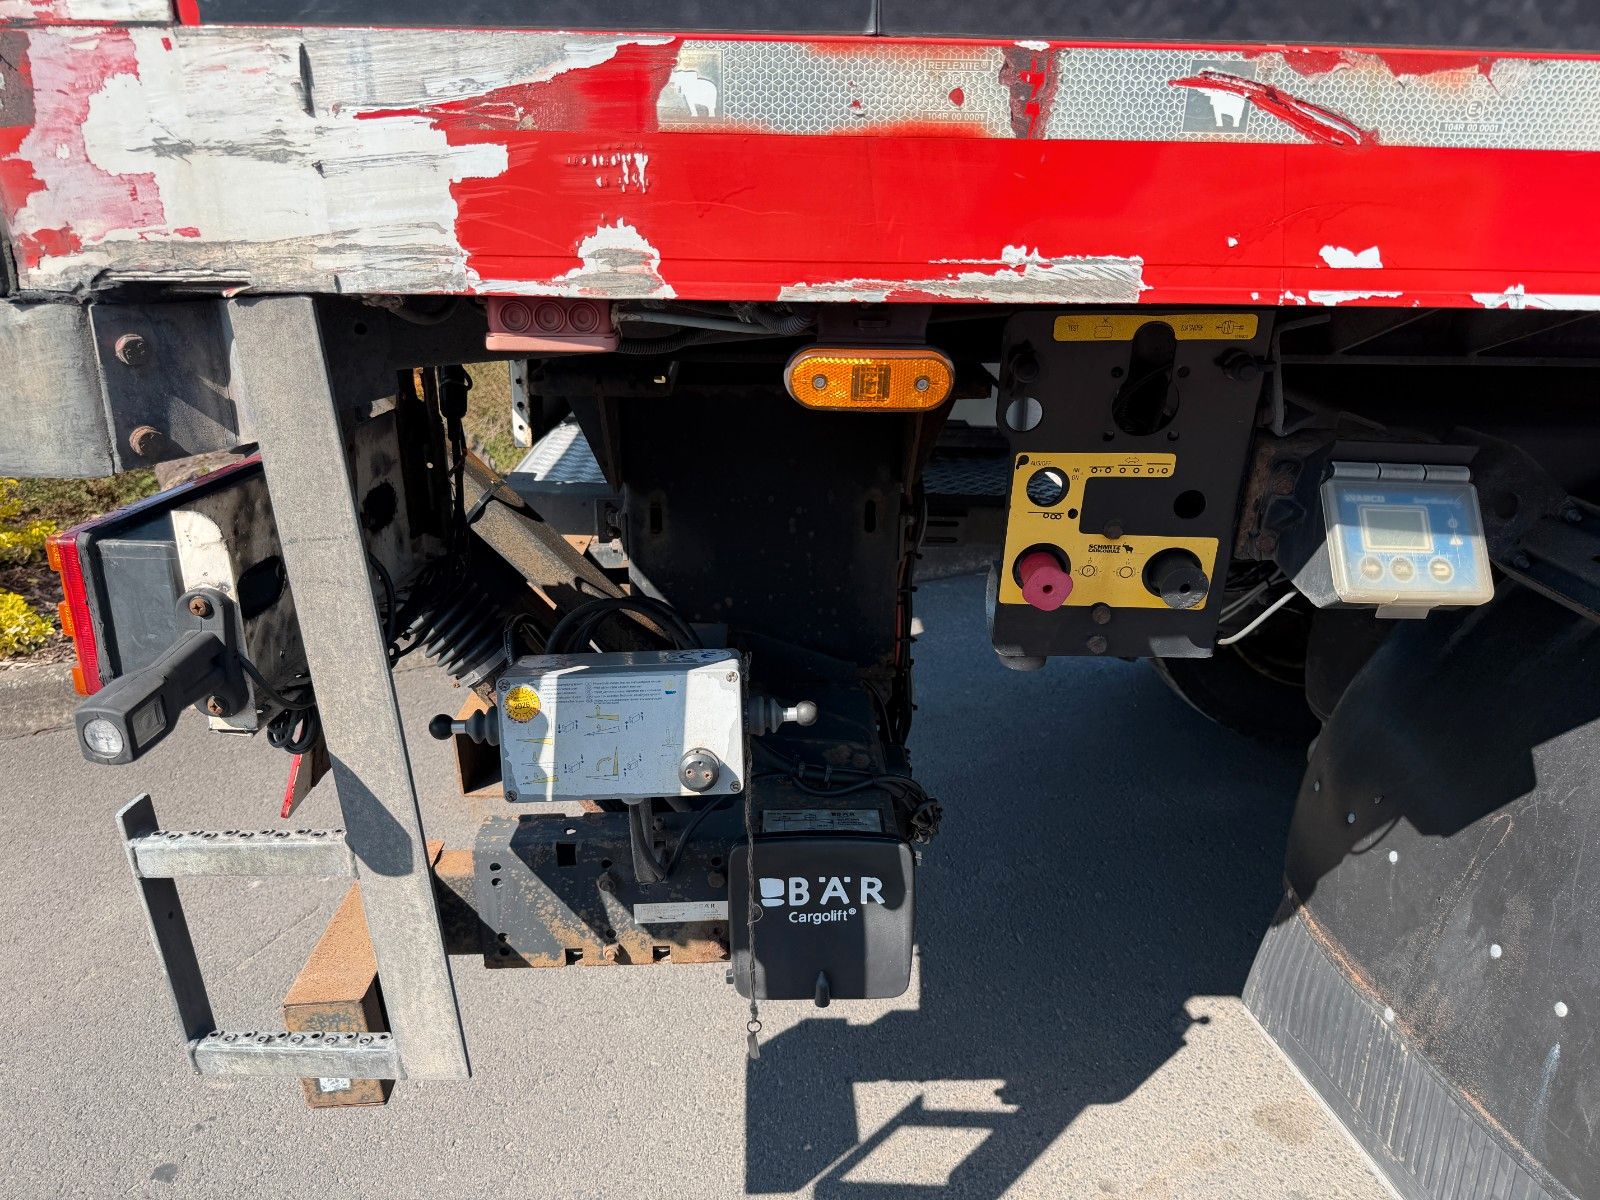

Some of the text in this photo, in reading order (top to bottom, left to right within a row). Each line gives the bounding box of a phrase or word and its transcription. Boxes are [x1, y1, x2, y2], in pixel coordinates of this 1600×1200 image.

[927, 112, 949, 121] 104R
[951, 113, 962, 121] 00
[1444, 123, 1499, 132] 104R 00 0001
[788, 876, 886, 906] BÄR
